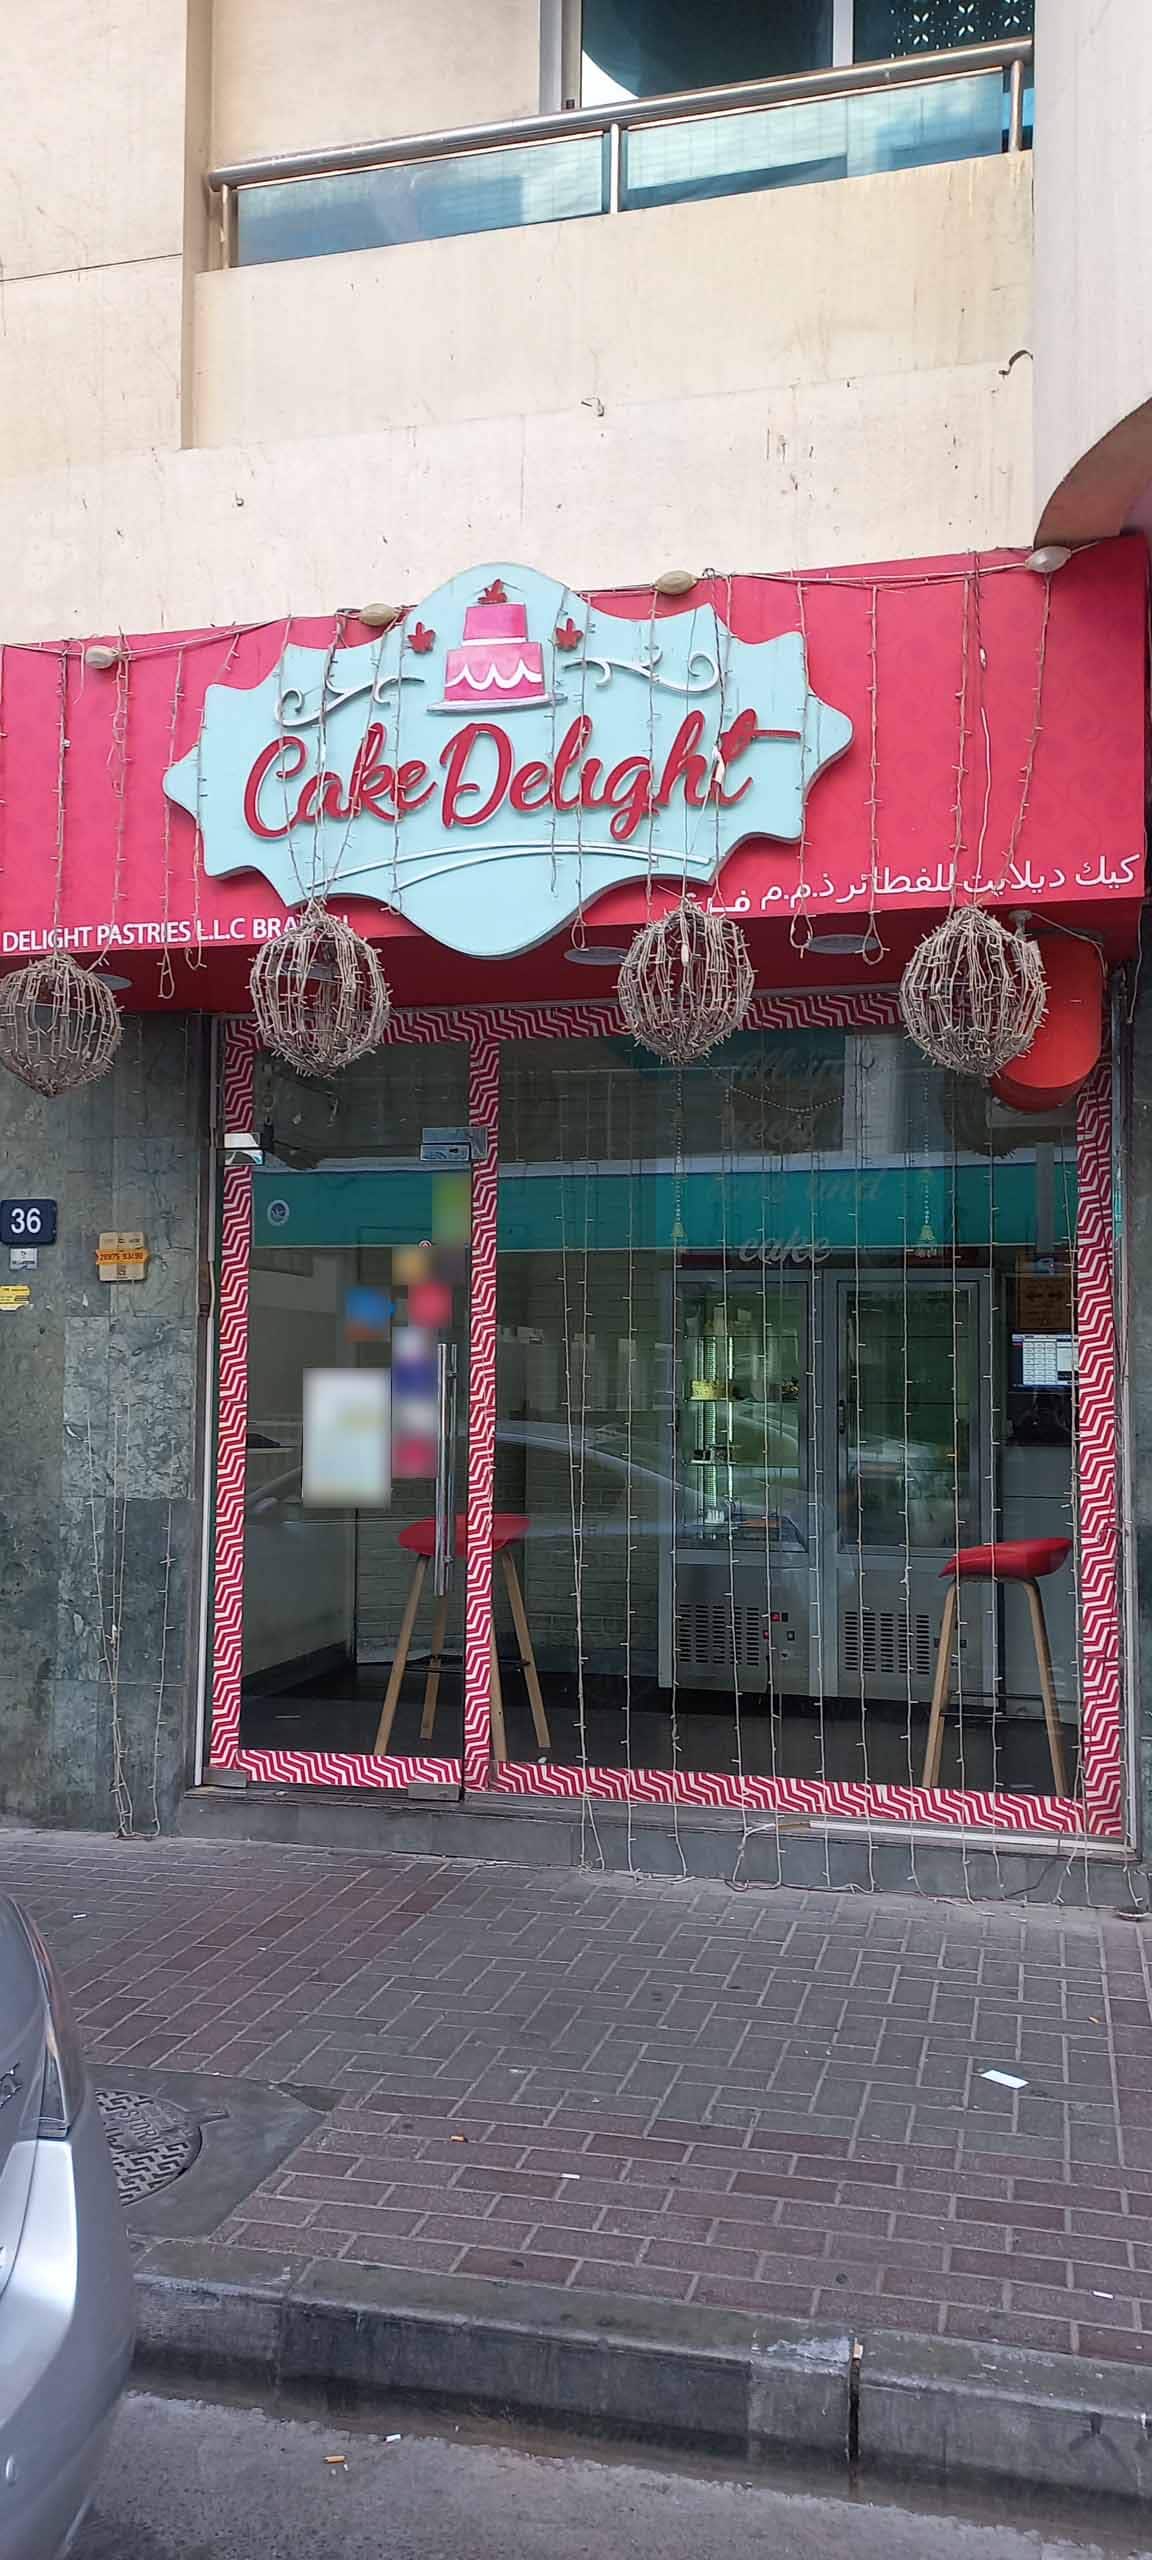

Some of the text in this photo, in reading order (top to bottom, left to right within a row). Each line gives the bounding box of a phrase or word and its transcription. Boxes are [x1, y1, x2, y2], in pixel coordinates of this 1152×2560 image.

[244, 707, 802, 842] Cake Delight
[835, 862, 955, 903] للفطائر
[961, 860, 1065, 896] ديلايت
[1075, 854, 1140, 889] كيك
[2, 926, 93, 952] DELIGHT
[96, 921, 190, 946] PASTRIES
[197, 917, 245, 941] L.L.C
[11, 1207, 42, 1234] 36
[737, 1229, 832, 1264] cake
